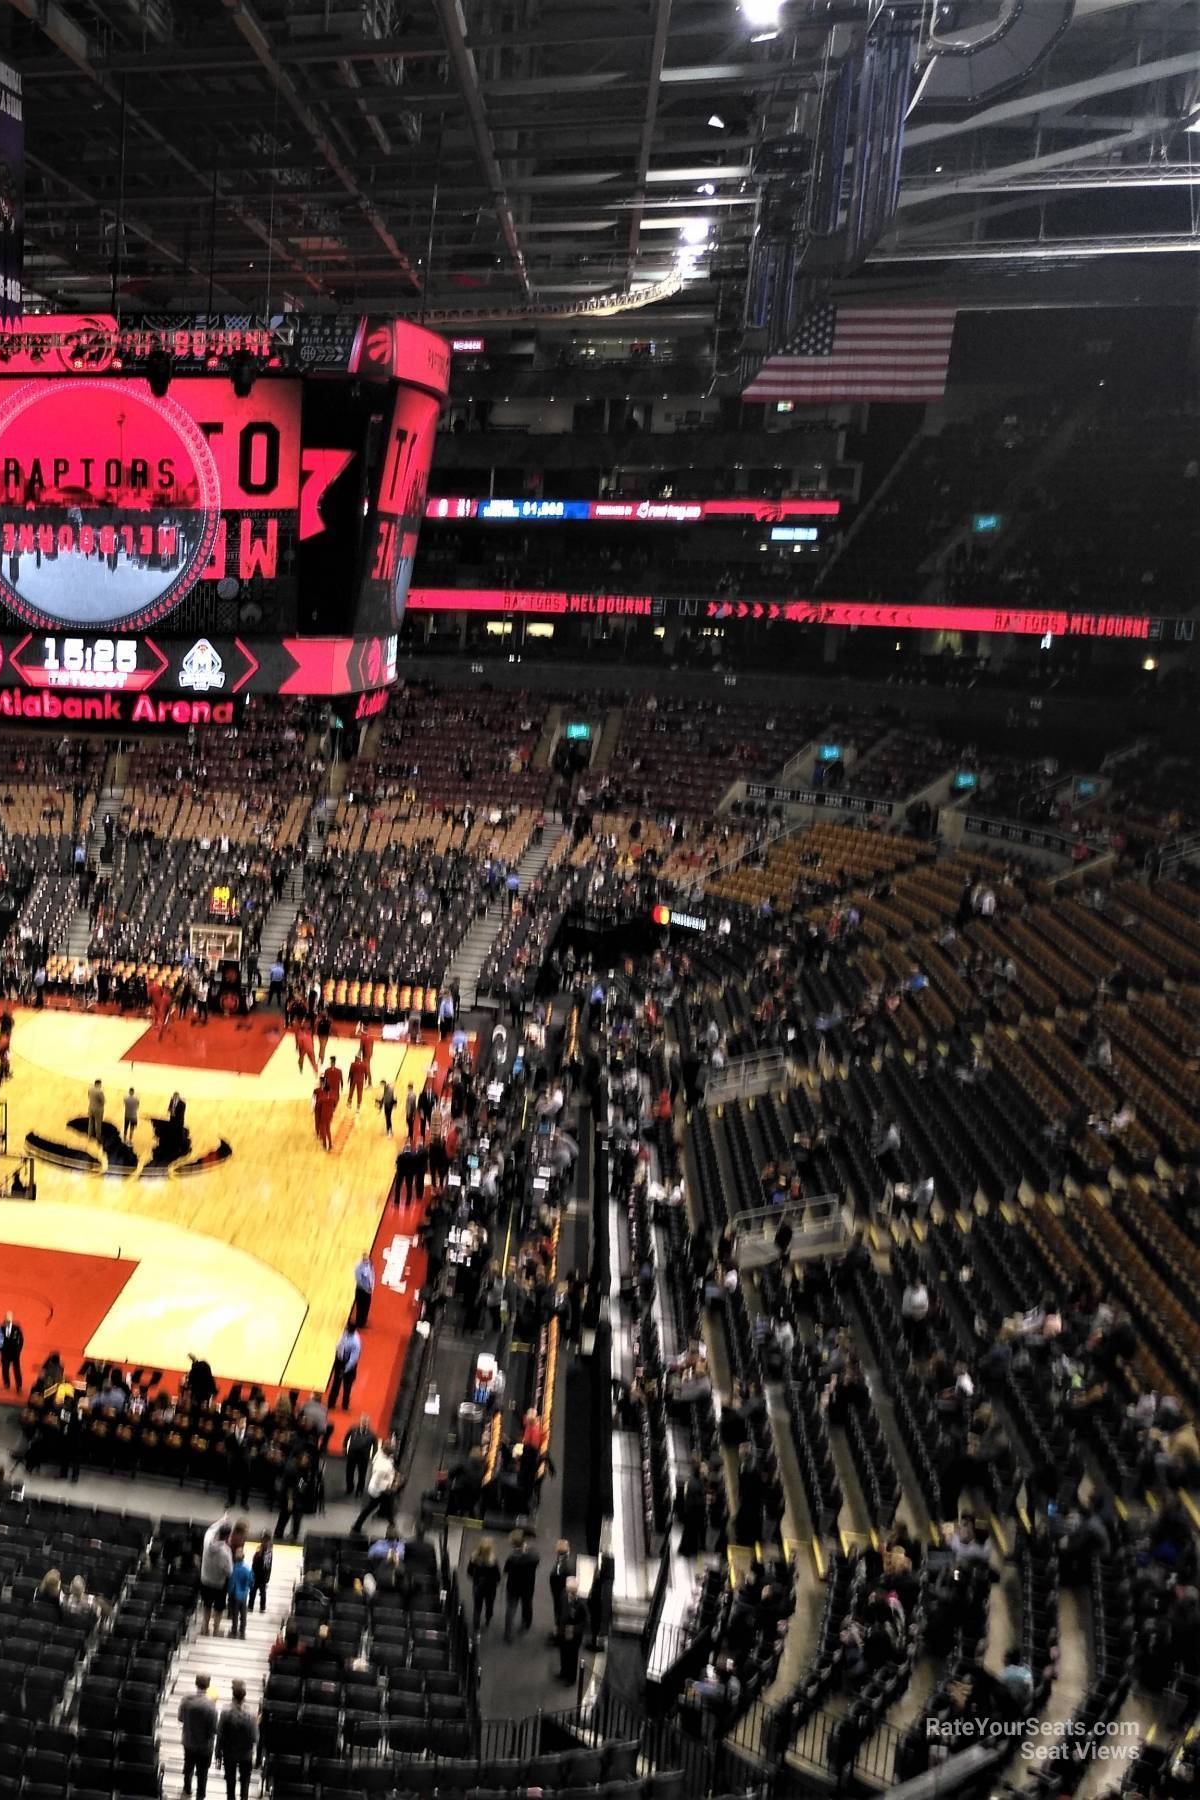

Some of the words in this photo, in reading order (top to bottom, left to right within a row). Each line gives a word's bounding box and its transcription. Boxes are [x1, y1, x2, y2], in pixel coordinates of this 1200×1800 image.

[3, 457, 175, 488] RAPTORS
[2, 523, 176, 556] MELBOURNE
[569, 593, 652, 615] MELBOURNE
[1070, 613, 1150, 639] MELBOURNE
[44, 637, 137, 673] 15:25
[131, 692, 234, 724] Arena
